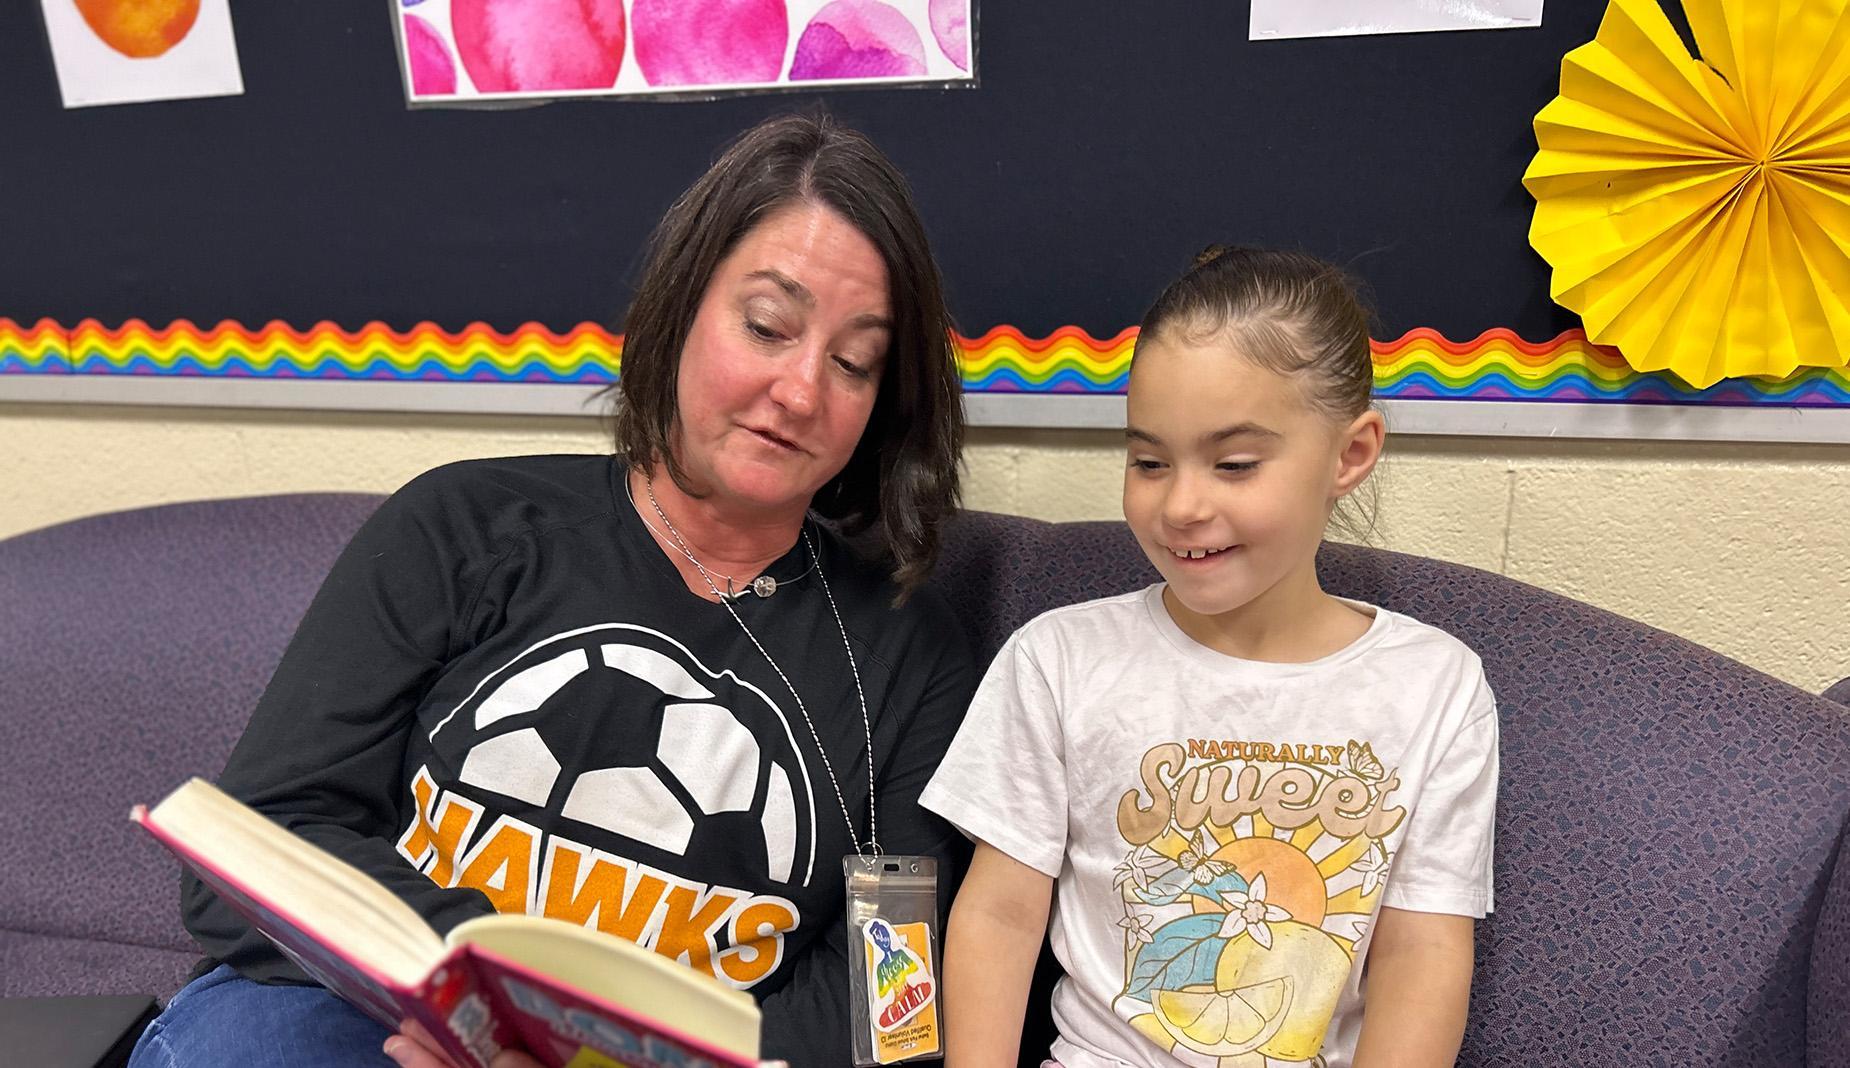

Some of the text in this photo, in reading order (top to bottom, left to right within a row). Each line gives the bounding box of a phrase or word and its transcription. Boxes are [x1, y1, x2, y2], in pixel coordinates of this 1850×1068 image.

[1187, 738, 1345, 766] NATURALLY
[1117, 742, 1407, 846] Sweet
[395, 764, 800, 990] HAWKS
[887, 985, 925, 1022] CALM
